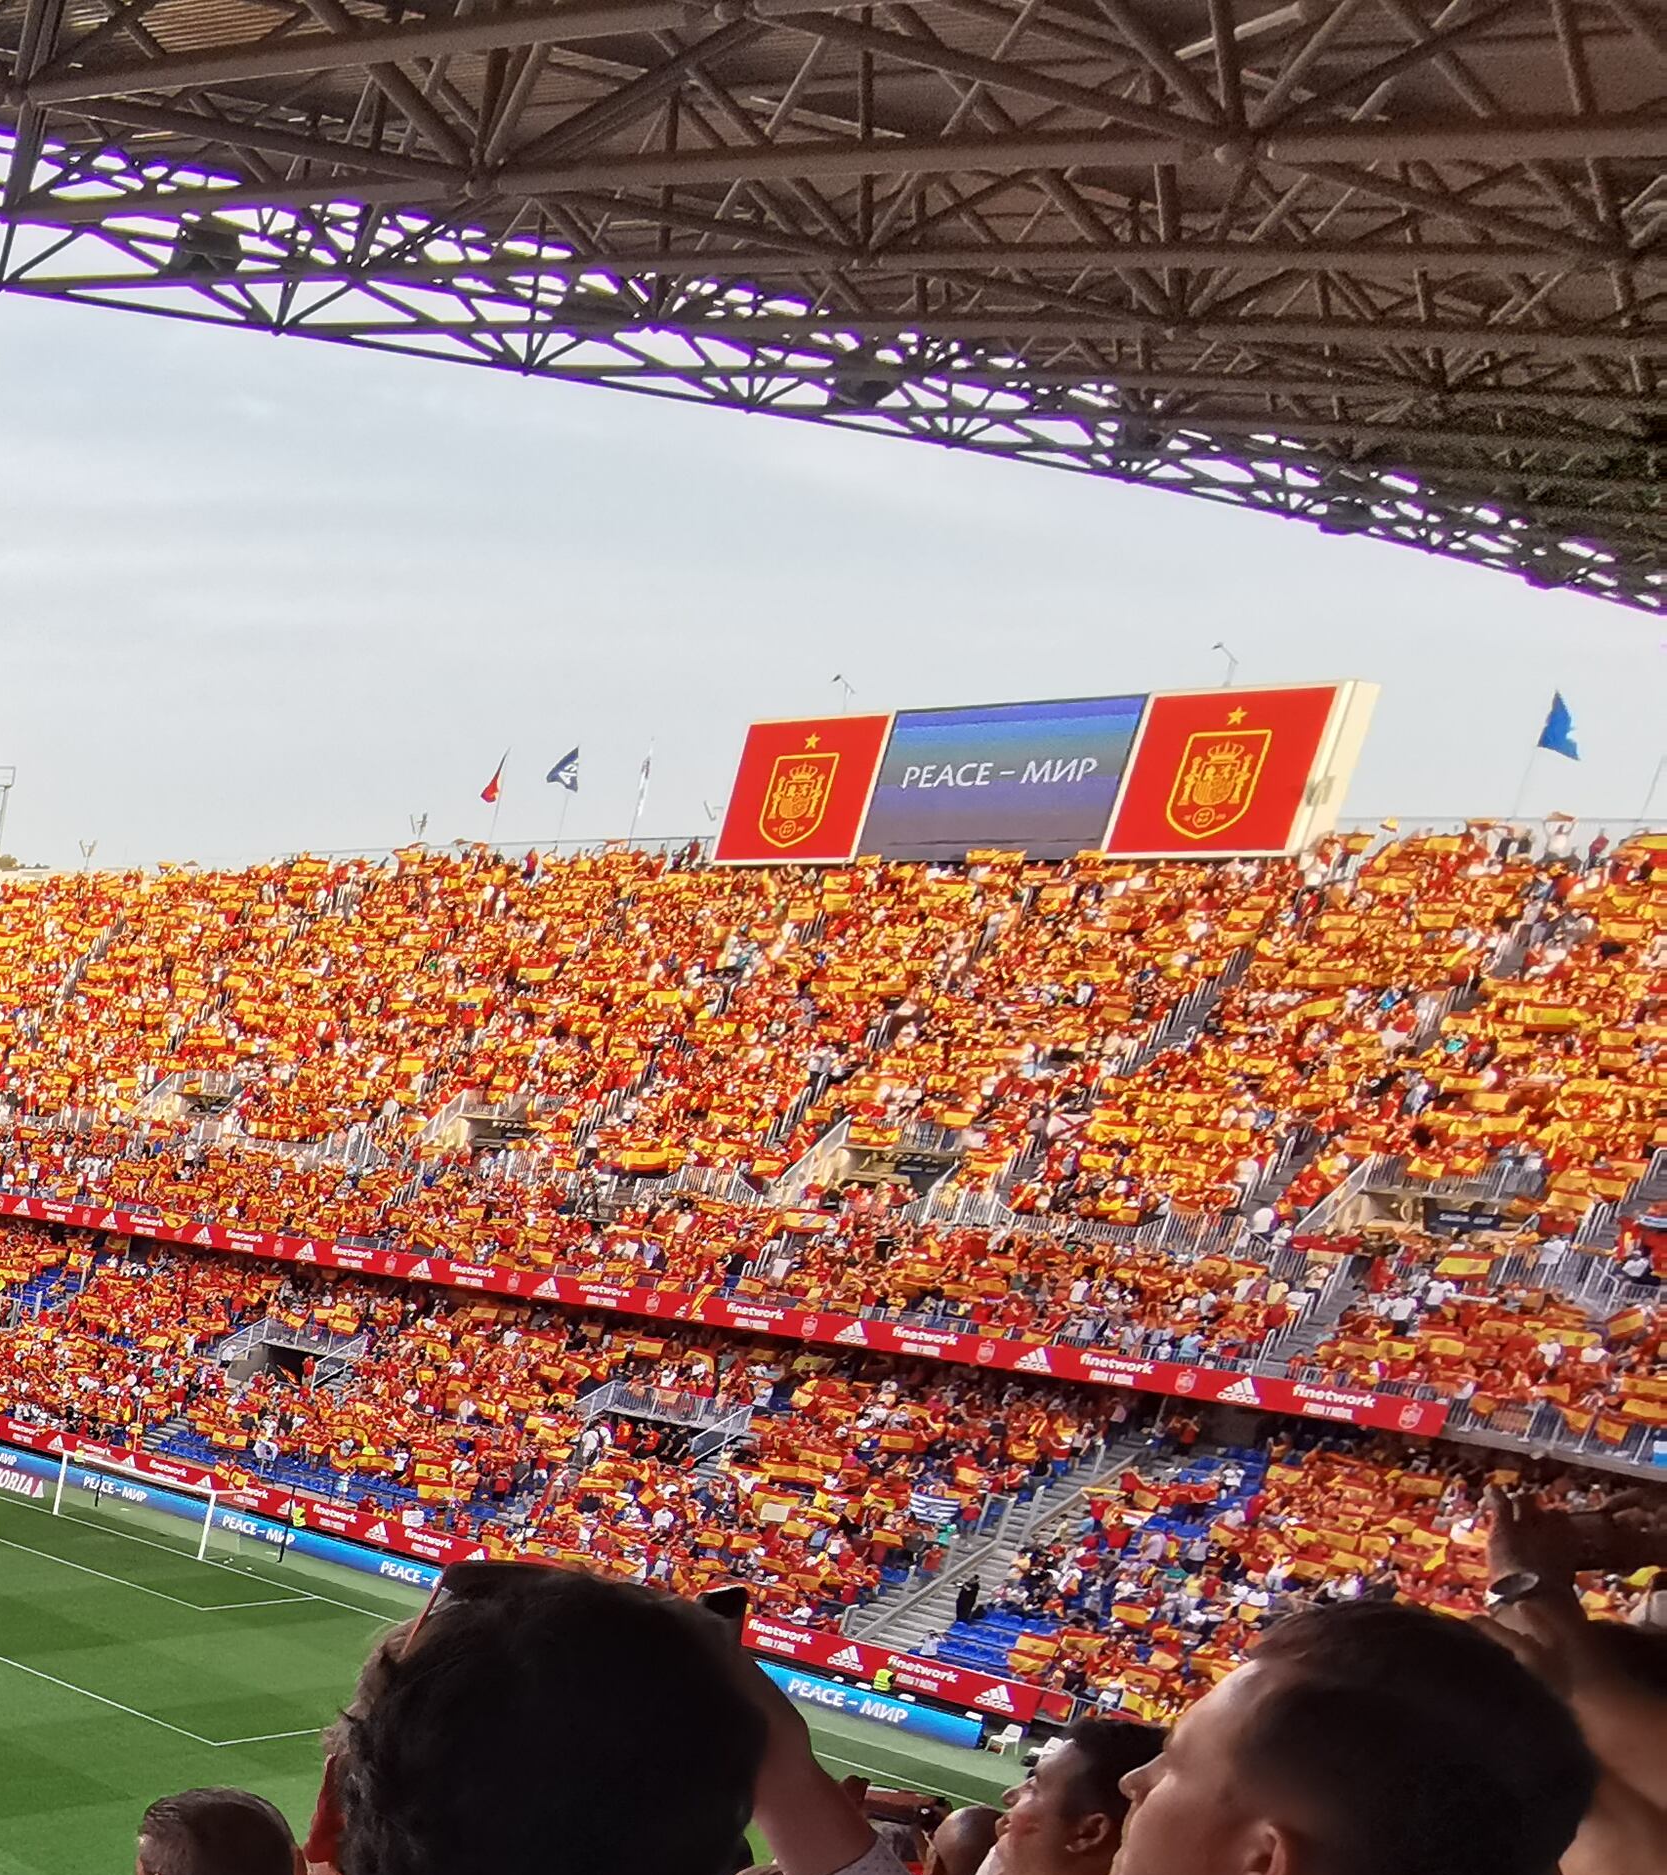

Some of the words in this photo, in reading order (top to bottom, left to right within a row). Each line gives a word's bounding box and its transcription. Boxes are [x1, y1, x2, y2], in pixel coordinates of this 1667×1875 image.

[900, 762, 993, 789] PEACE
[1019, 756, 1098, 785] МИР
[1081, 1354, 1154, 1374] finetwork
[1293, 1384, 1376, 1408] finetwork
[788, 1679, 847, 1708] PEACE
[860, 1701, 909, 1724] МИР
